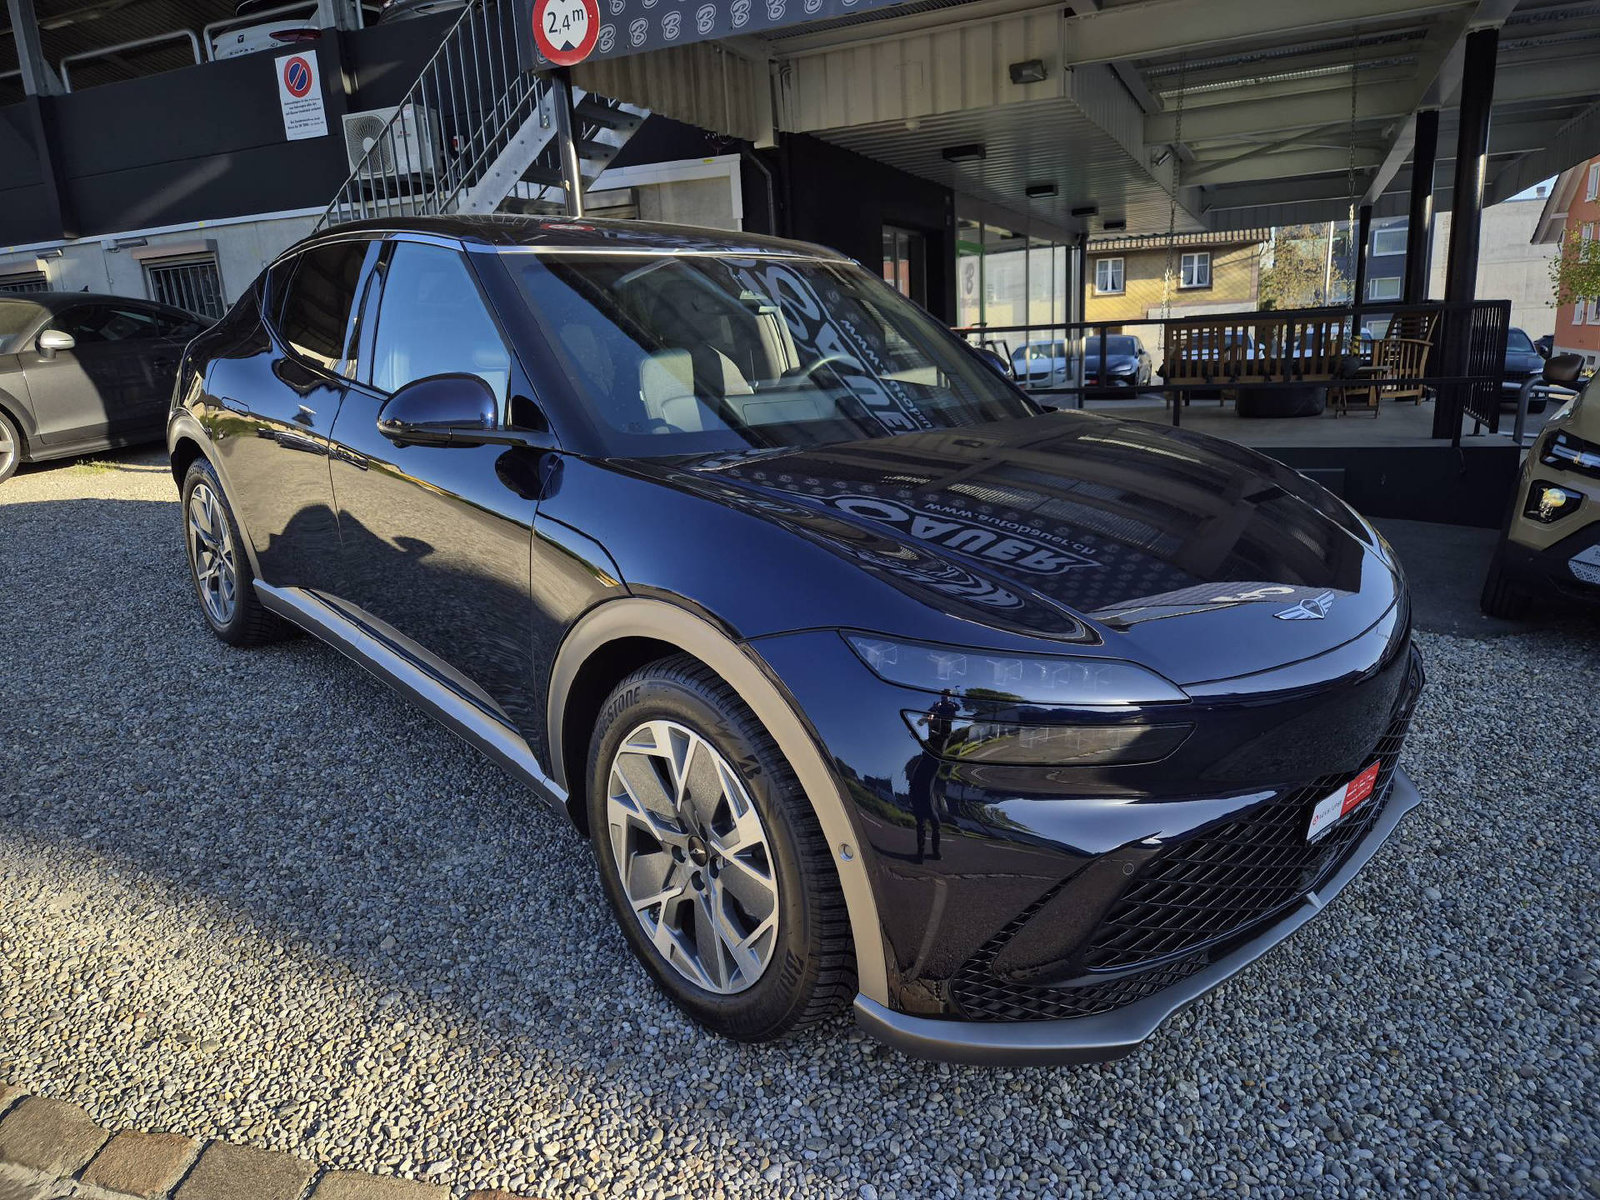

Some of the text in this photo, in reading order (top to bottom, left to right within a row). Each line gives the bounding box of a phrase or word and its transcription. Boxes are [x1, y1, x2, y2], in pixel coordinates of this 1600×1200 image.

[599, 24, 616, 53] B
[629, 18, 649, 47] B
[661, 11, 681, 40] B
[696, 3, 716, 34] B
[731, 0, 751, 28] B
